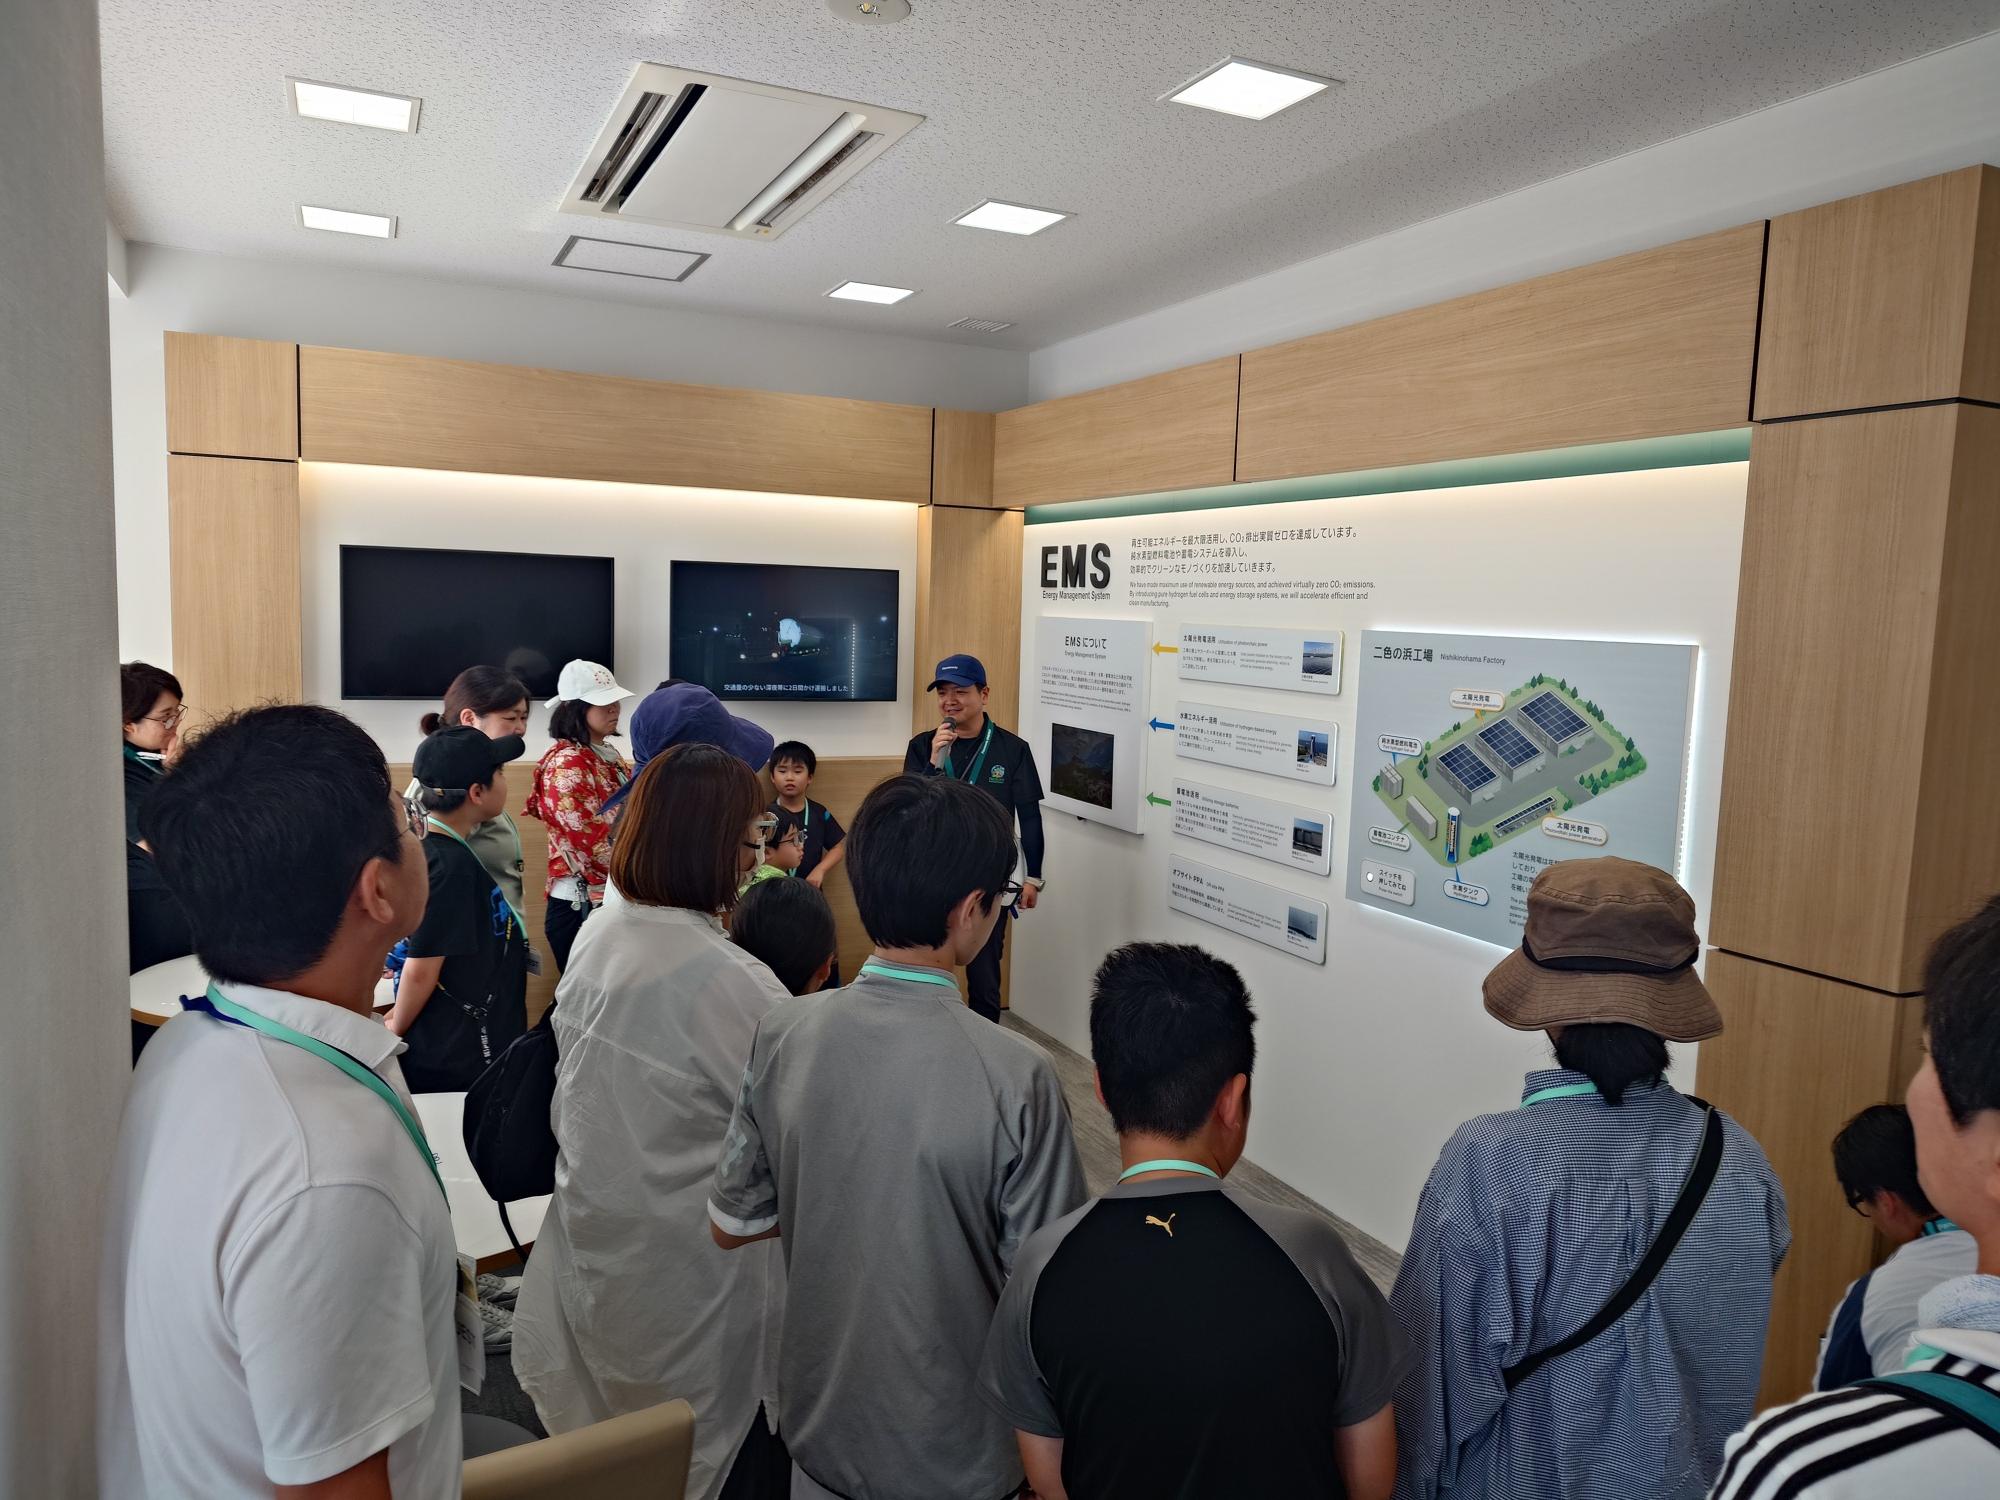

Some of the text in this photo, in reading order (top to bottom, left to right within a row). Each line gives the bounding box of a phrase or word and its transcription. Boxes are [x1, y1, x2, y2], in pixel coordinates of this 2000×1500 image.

[1041, 542, 1111, 588] EMS
[1218, 582, 1234, 590] energy
[1293, 580, 1314, 589] virtually
[1042, 590, 1111, 601] Energy Management System
[1129, 590, 1134, 598] By
[1220, 592, 1236, 600] energy
[1237, 592, 1256, 600] storage
[1290, 591, 1299, 599] will
[1300, 591, 1329, 599] accelerate
[1356, 592, 1368, 600] and
[1373, 646, 1433, 662] 二色の浜工場
[1440, 653, 1506, 665] Nishikinohama Factory
[1462, 693, 1490, 703] 太陽光発電
[1180, 712, 1218, 724] 水素エネルギー活用
[1176, 787, 1200, 799] 蓄電池活用
[1557, 822, 1590, 834] 太陽光発電
[1373, 830, 1405, 842] 蓄電池コンテナ
[1379, 870, 1402, 881] スイッチを
[1379, 878, 1406, 891] 押してみてね
[1453, 885, 1478, 895] 水素タンク
